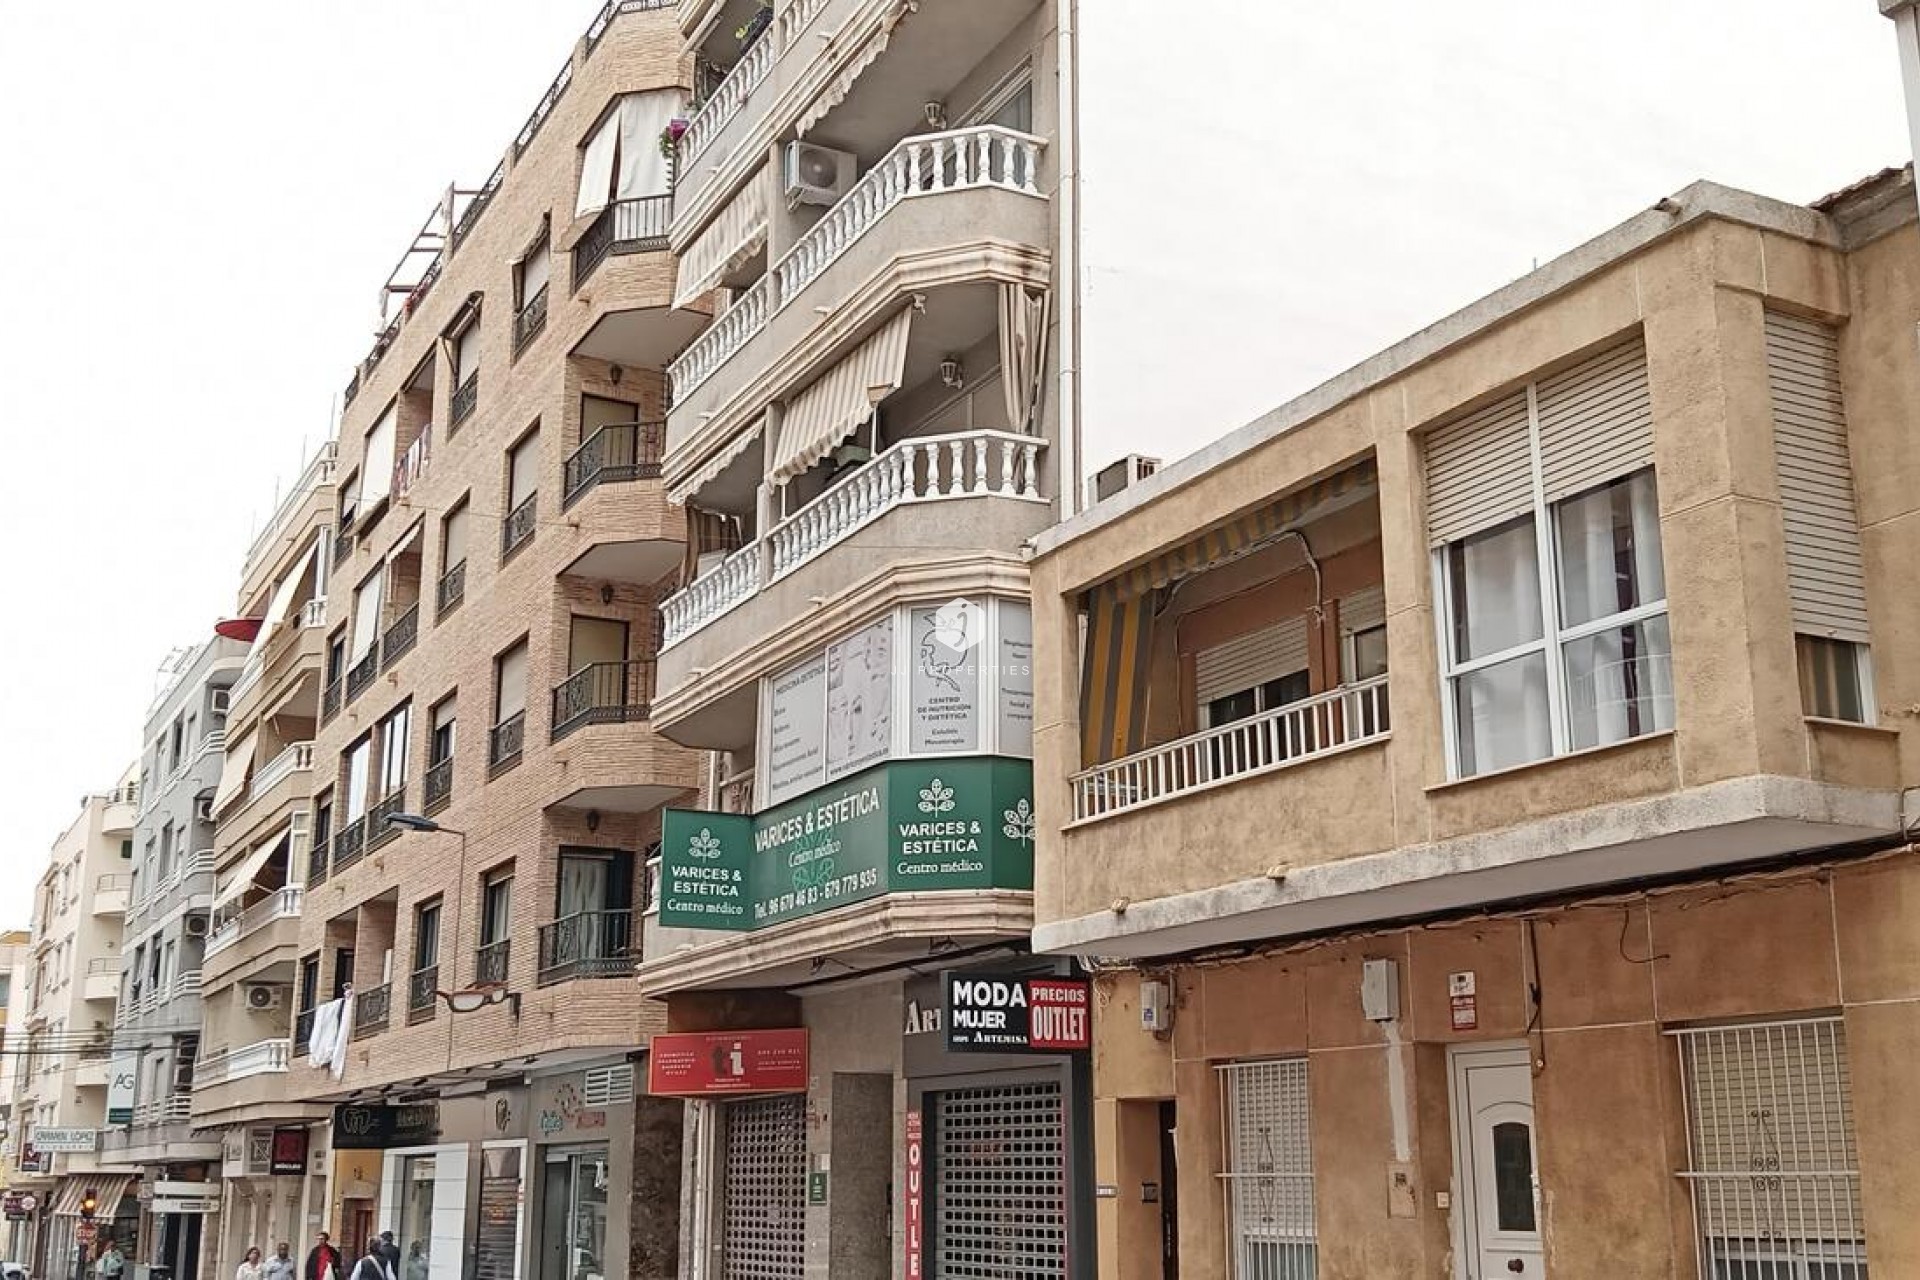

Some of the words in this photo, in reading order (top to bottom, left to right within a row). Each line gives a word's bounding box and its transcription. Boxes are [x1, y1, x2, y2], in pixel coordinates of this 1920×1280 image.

[754, 815, 803, 854] VARICES
[805, 811, 814, 835] &
[817, 787, 880, 831] ESTÉTICA
[899, 821, 966, 838] VARICES
[969, 820, 982, 835] &
[903, 836, 979, 855] ESTÉTICA
[788, 849, 814, 868] Centro
[897, 861, 938, 875] Centro
[940, 859, 984, 873] médico
[671, 865, 730, 881] VARICES
[731, 869, 742, 882] &
[673, 880, 739, 897] ESTÉTICA
[667, 898, 705, 913] Centro
[705, 901, 744, 915] médico
[953, 980, 1028, 1007] MODA
[1031, 986, 1086, 1004] PRECIOS
[953, 1009, 1007, 1030] MUJER
[1032, 1005, 1087, 1042] OUTLET
